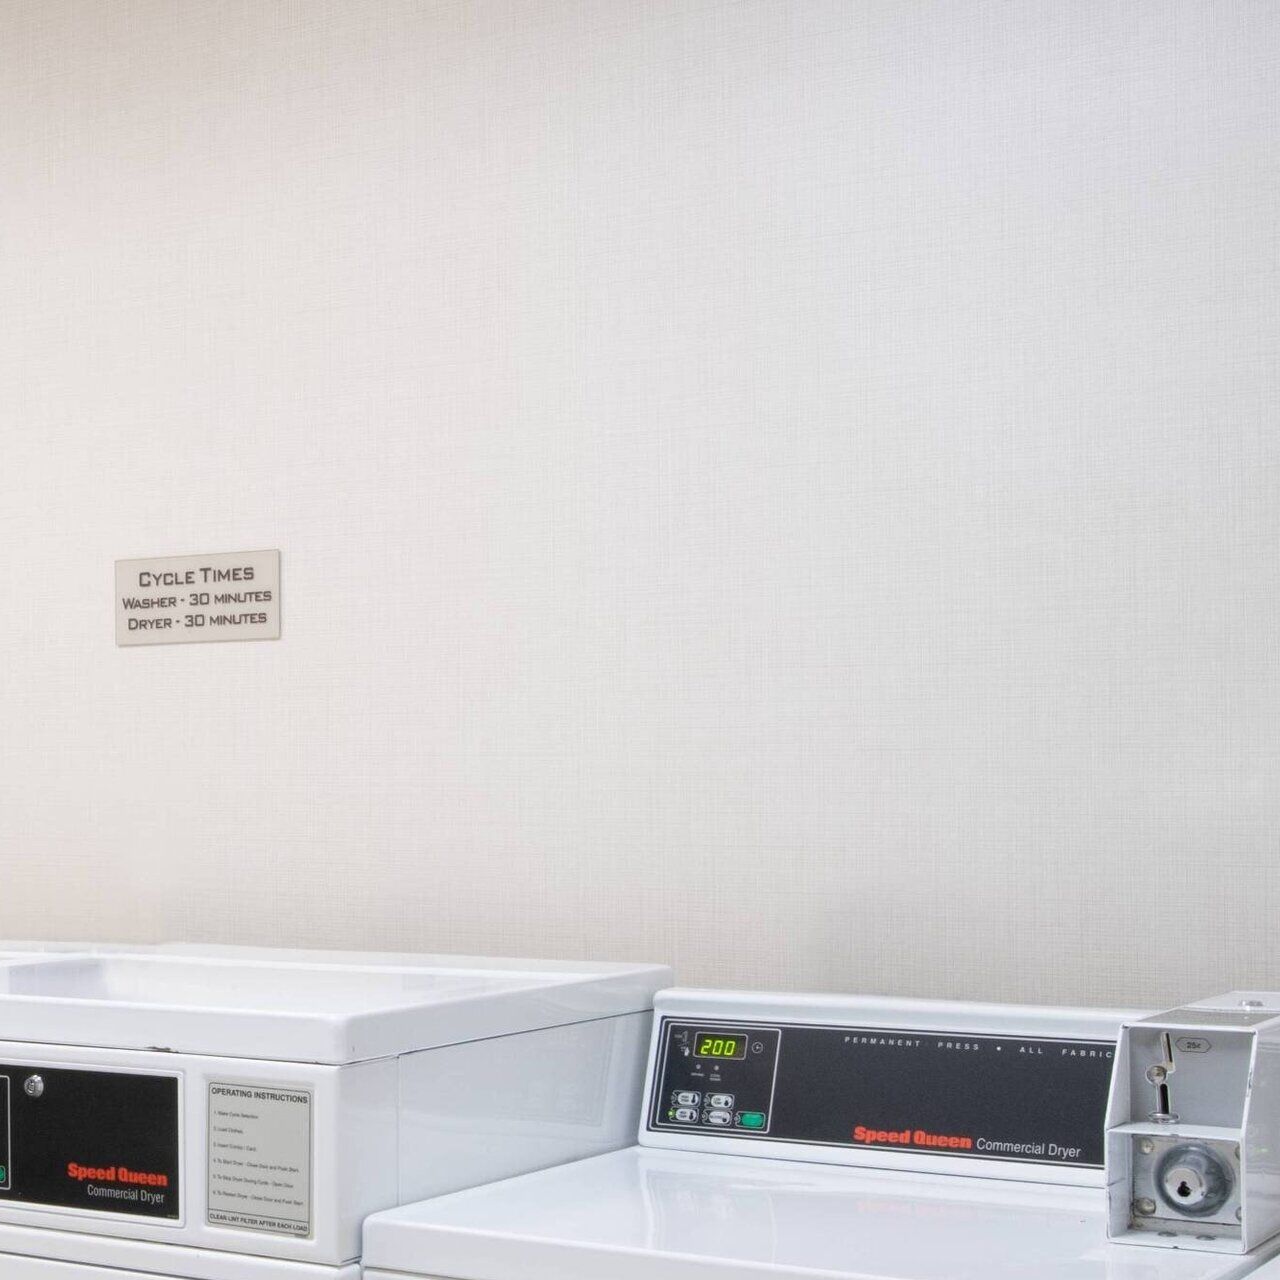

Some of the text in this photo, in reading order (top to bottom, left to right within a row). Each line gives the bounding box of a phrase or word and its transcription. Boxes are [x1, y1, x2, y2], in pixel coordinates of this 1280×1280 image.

[189, 592, 210, 606] 30
[184, 614, 205, 628] 30
[700, 1039, 736, 1056] 200
[844, 1036, 1113, 1059] PERMANENT PRESS ALL FABRIC
[211, 1087, 308, 1104] OPERATING INSTRUCTIONS
[853, 1125, 1082, 1161] Speed Queen Commercial Dryer
[67, 1162, 168, 1187] Speed Queen
[87, 1184, 165, 1205] Commercial Dryer
[240, 1217, 258, 1225] FILTER
[258, 1219, 276, 1227] AFTER
